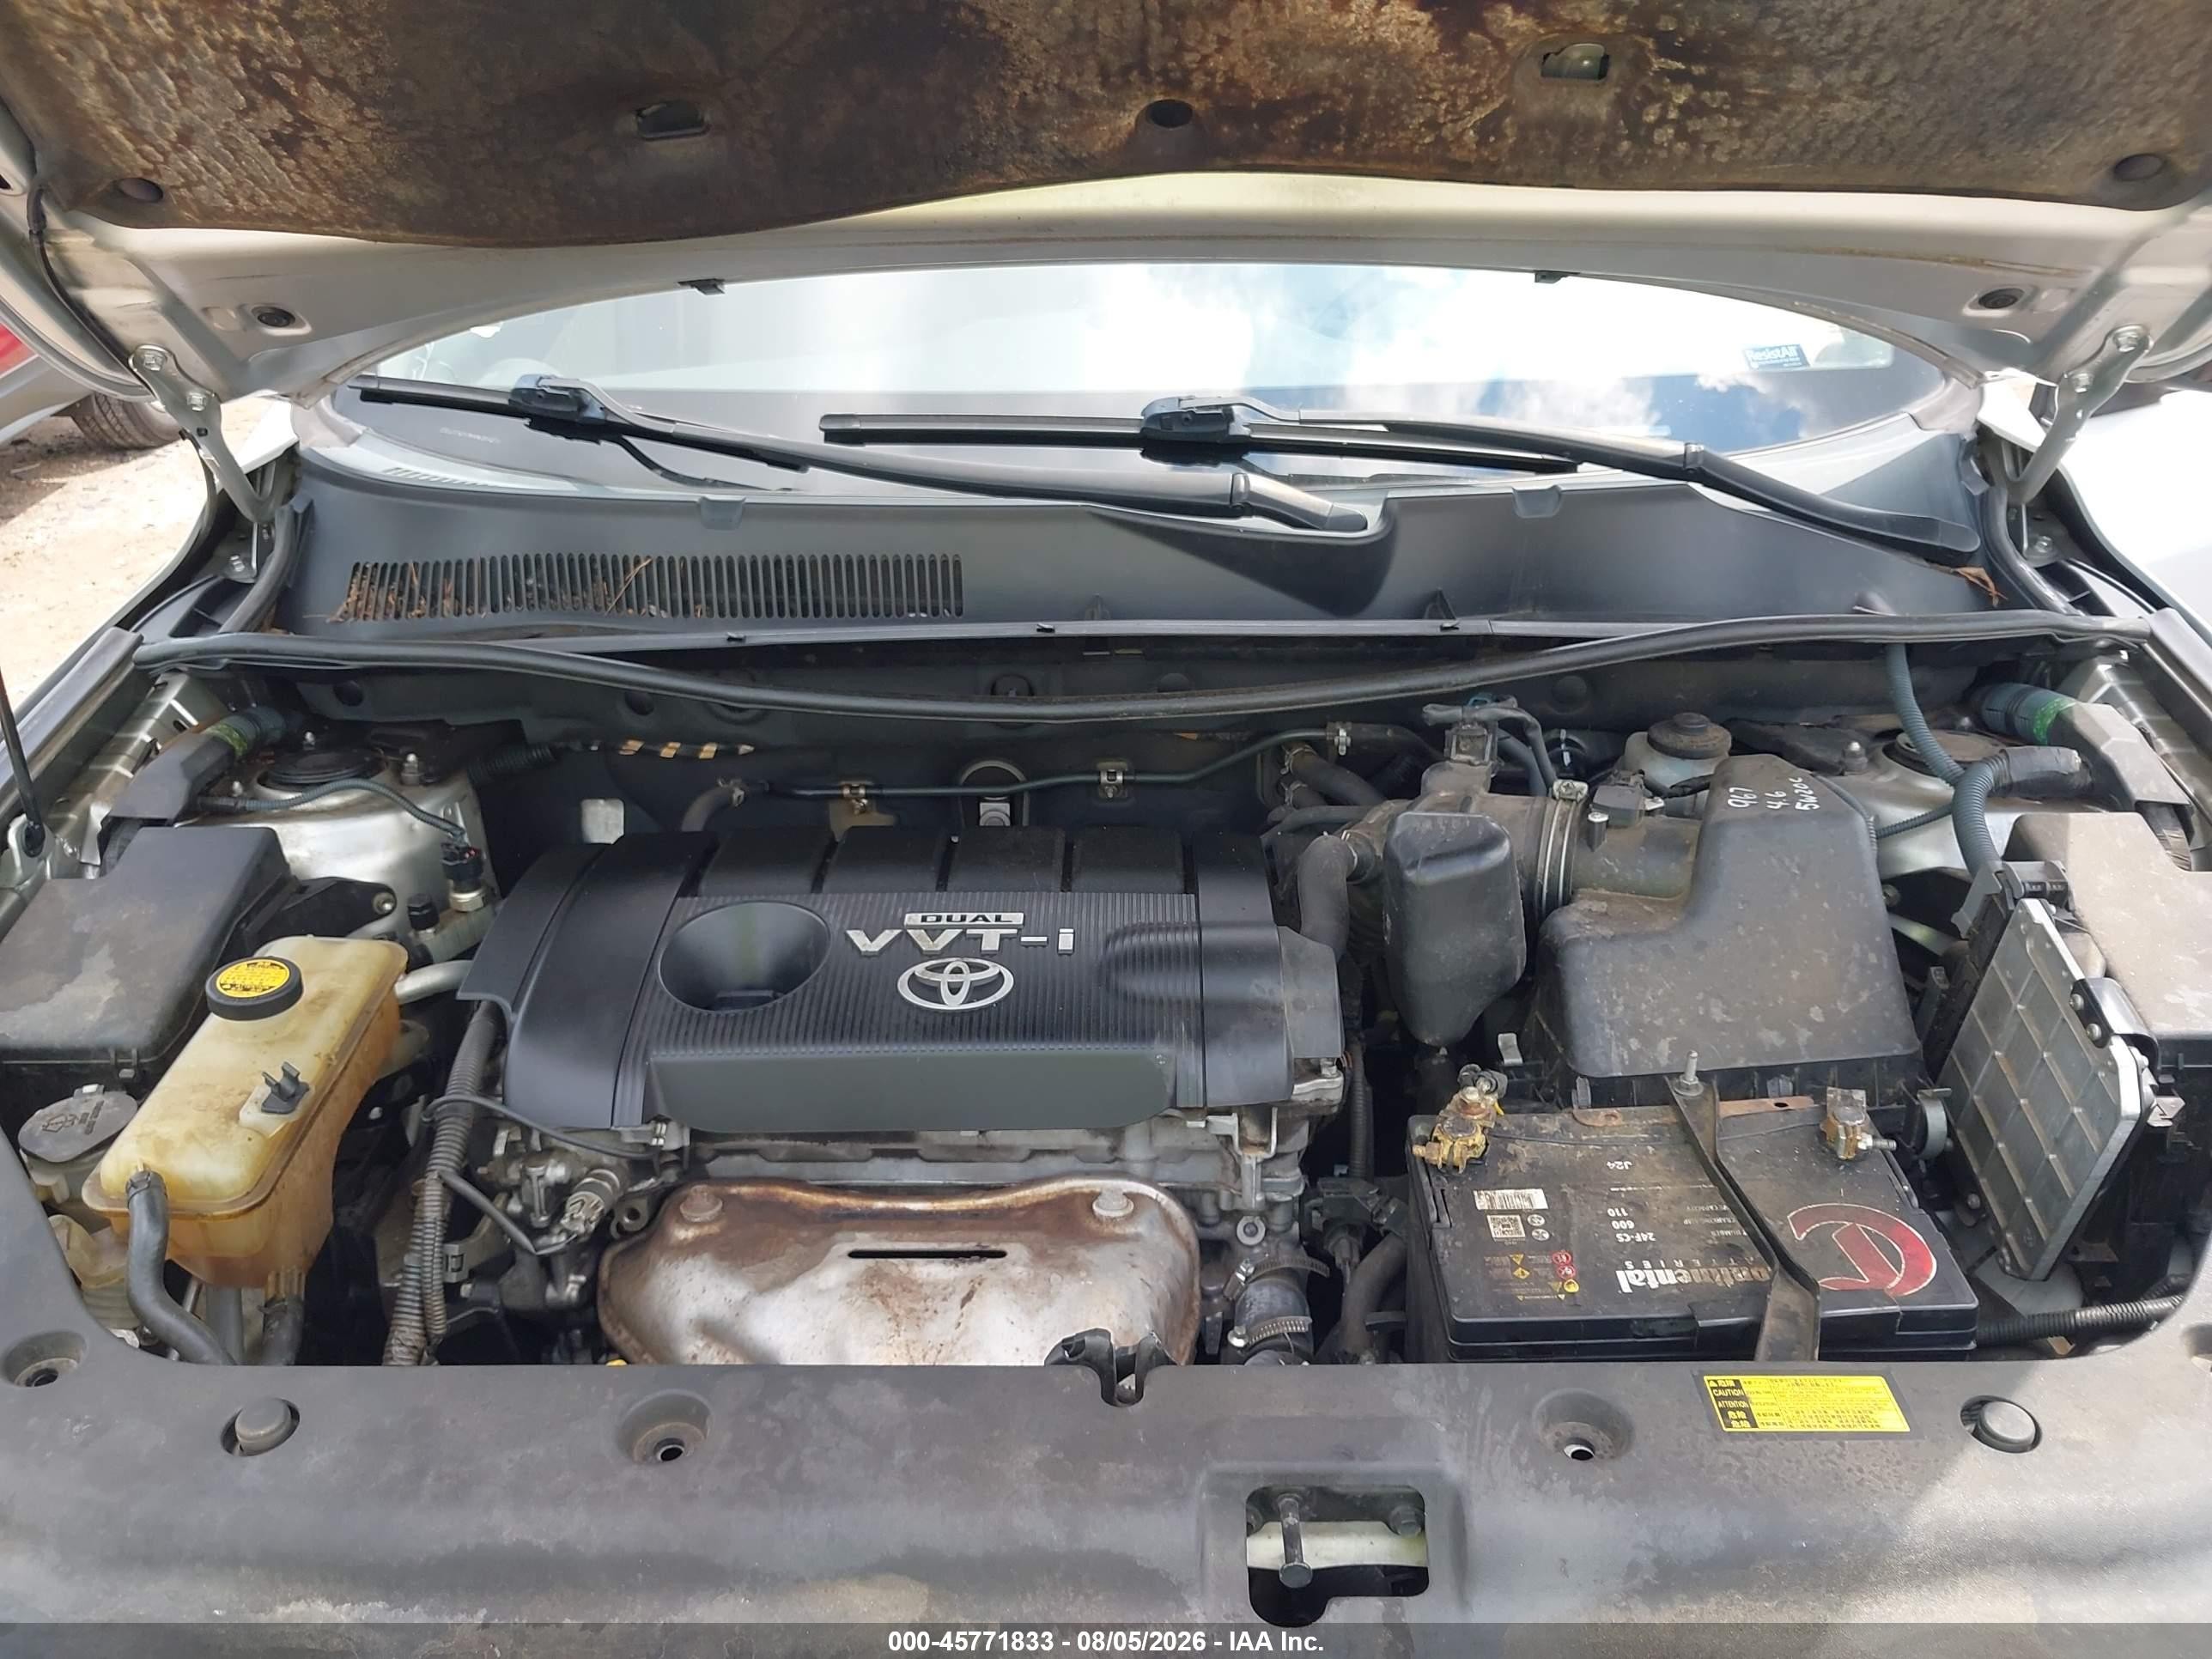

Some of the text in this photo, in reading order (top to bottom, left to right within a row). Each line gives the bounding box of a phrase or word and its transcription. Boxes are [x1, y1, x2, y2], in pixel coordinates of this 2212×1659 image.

[1727, 787, 1759, 808] 967
[921, 915, 1013, 923] DUAL
[846, 928, 1073, 954] VVT-i
[1607, 1160, 1633, 1170] J24
[1607, 1207, 1629, 1217] 110
[1612, 1220, 1635, 1230] 600
[1623, 1256, 1755, 1270] ATTERIES
[1615, 1267, 1771, 1294] ontinental
[1713, 1389, 1745, 1397] CAUTION
[1717, 1400, 1749, 1408] ATTENTION
